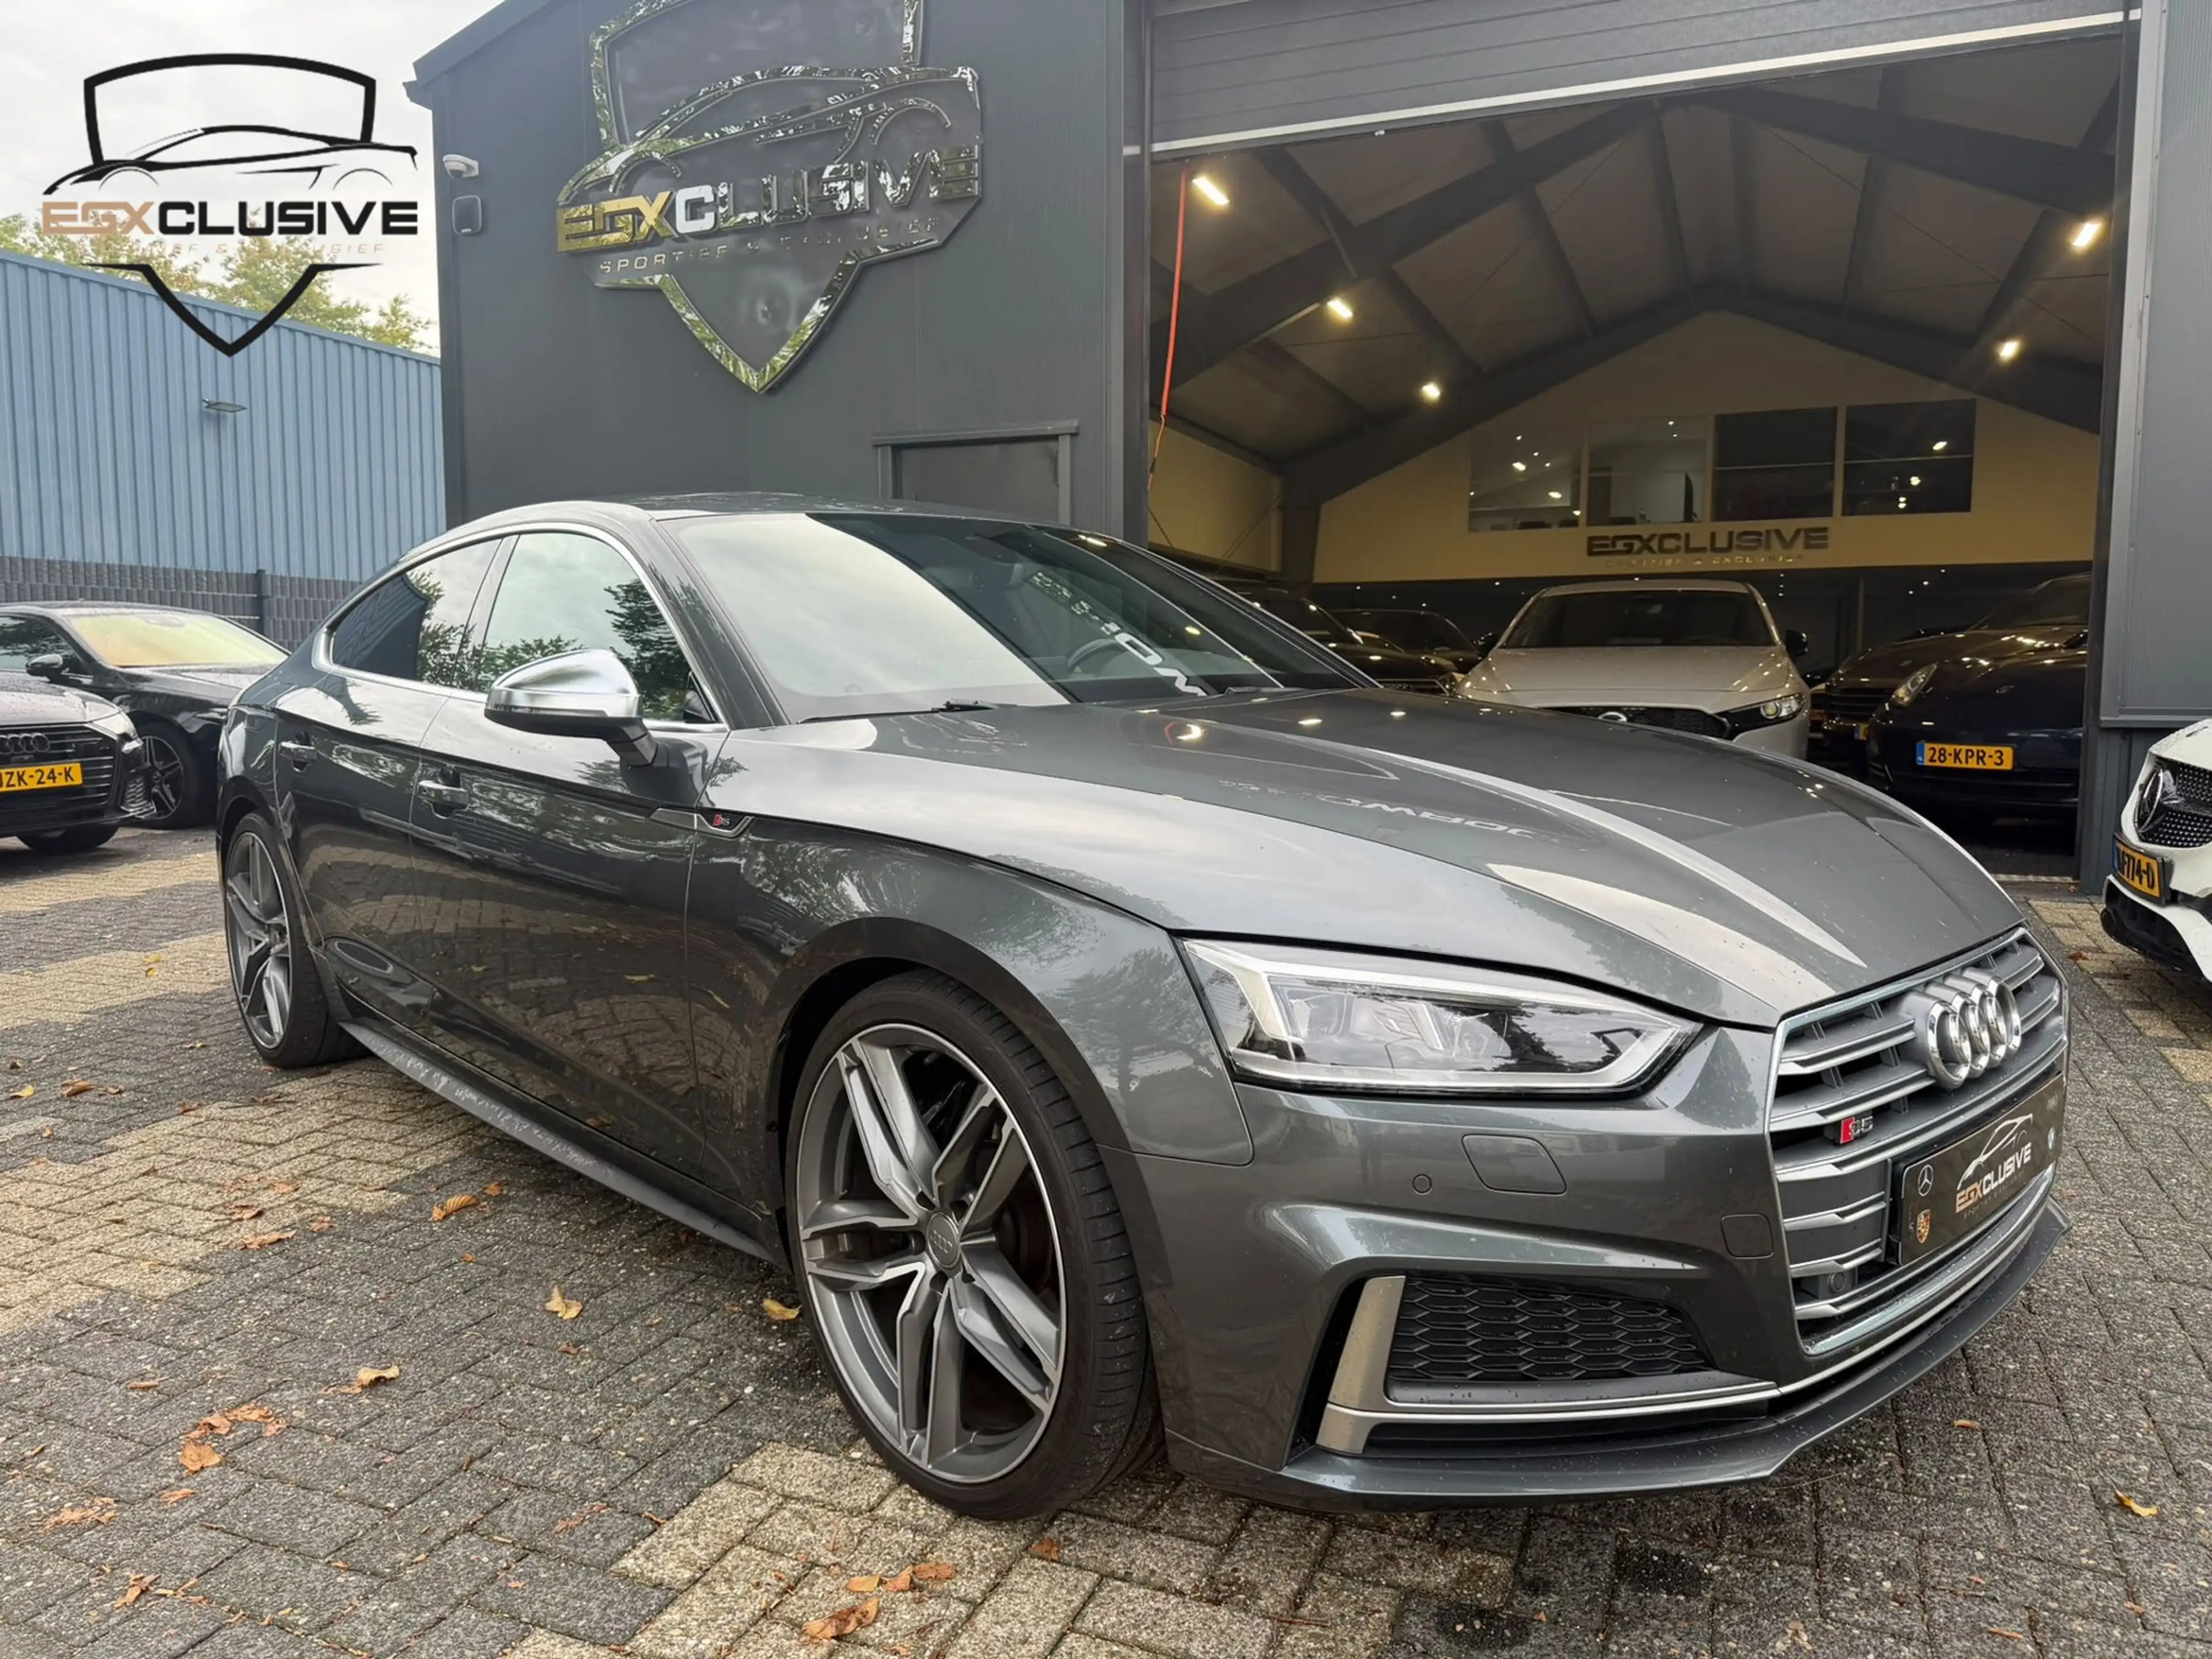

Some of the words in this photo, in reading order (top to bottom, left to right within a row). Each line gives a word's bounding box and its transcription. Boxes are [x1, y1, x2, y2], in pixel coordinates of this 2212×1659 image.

[558, 144, 980, 252] EGXCLUSIVE
[600, 245, 727, 273] SPORTIEF
[1587, 527, 1829, 556] EGXCLUSIVE
[1929, 747, 2004, 766] 28-KPR-3
[1849, 1116, 1873, 1138] S5
[1955, 1142, 2032, 1214] EGXCLUSIVE
